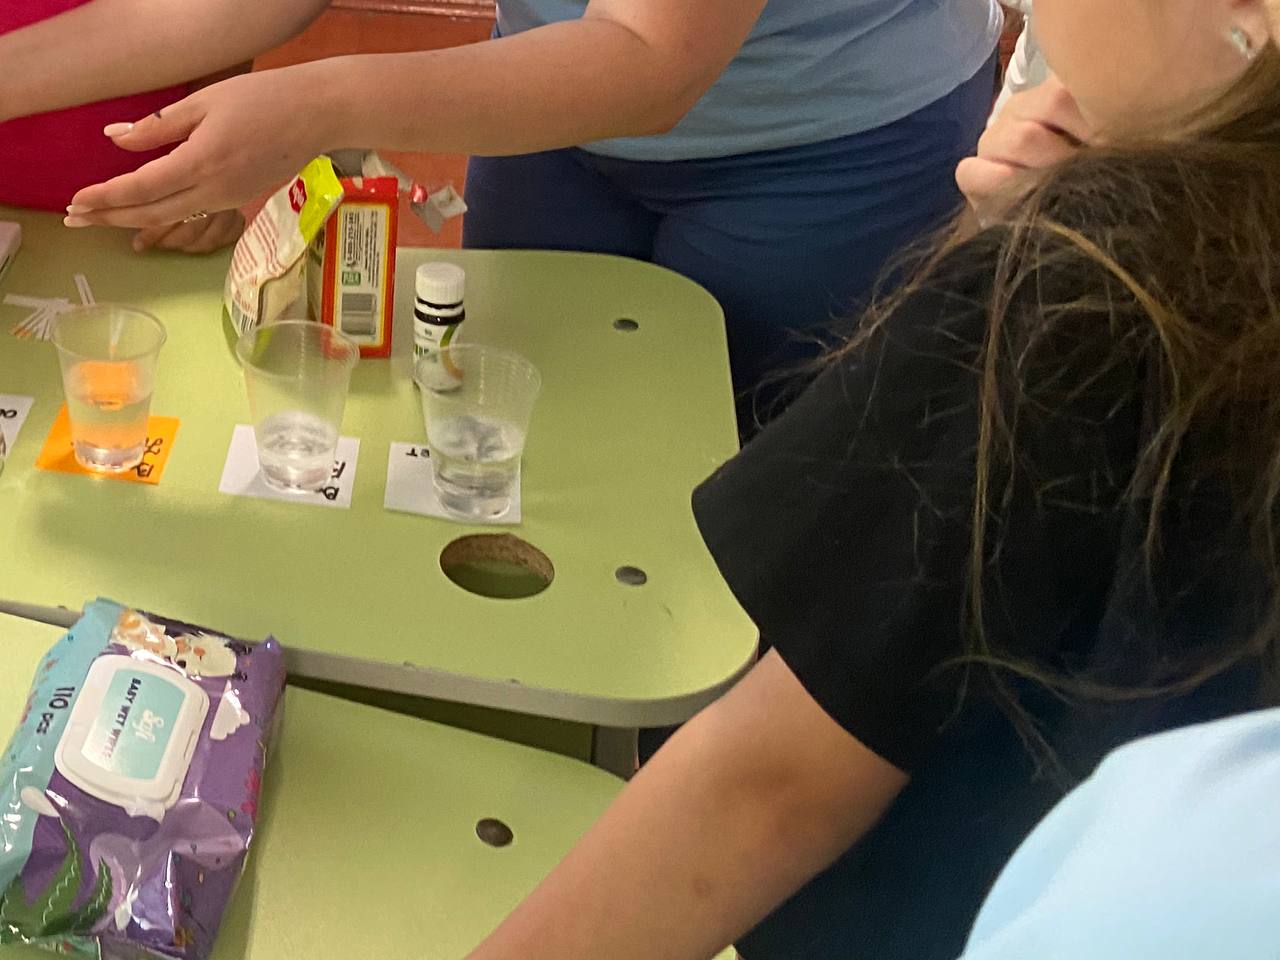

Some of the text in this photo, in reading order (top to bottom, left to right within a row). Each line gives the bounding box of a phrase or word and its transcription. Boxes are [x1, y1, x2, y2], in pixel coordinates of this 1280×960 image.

[125, 677, 142, 704] BABY
[36, 686, 76, 735] 110 pcs
[115, 704, 131, 727] WET
